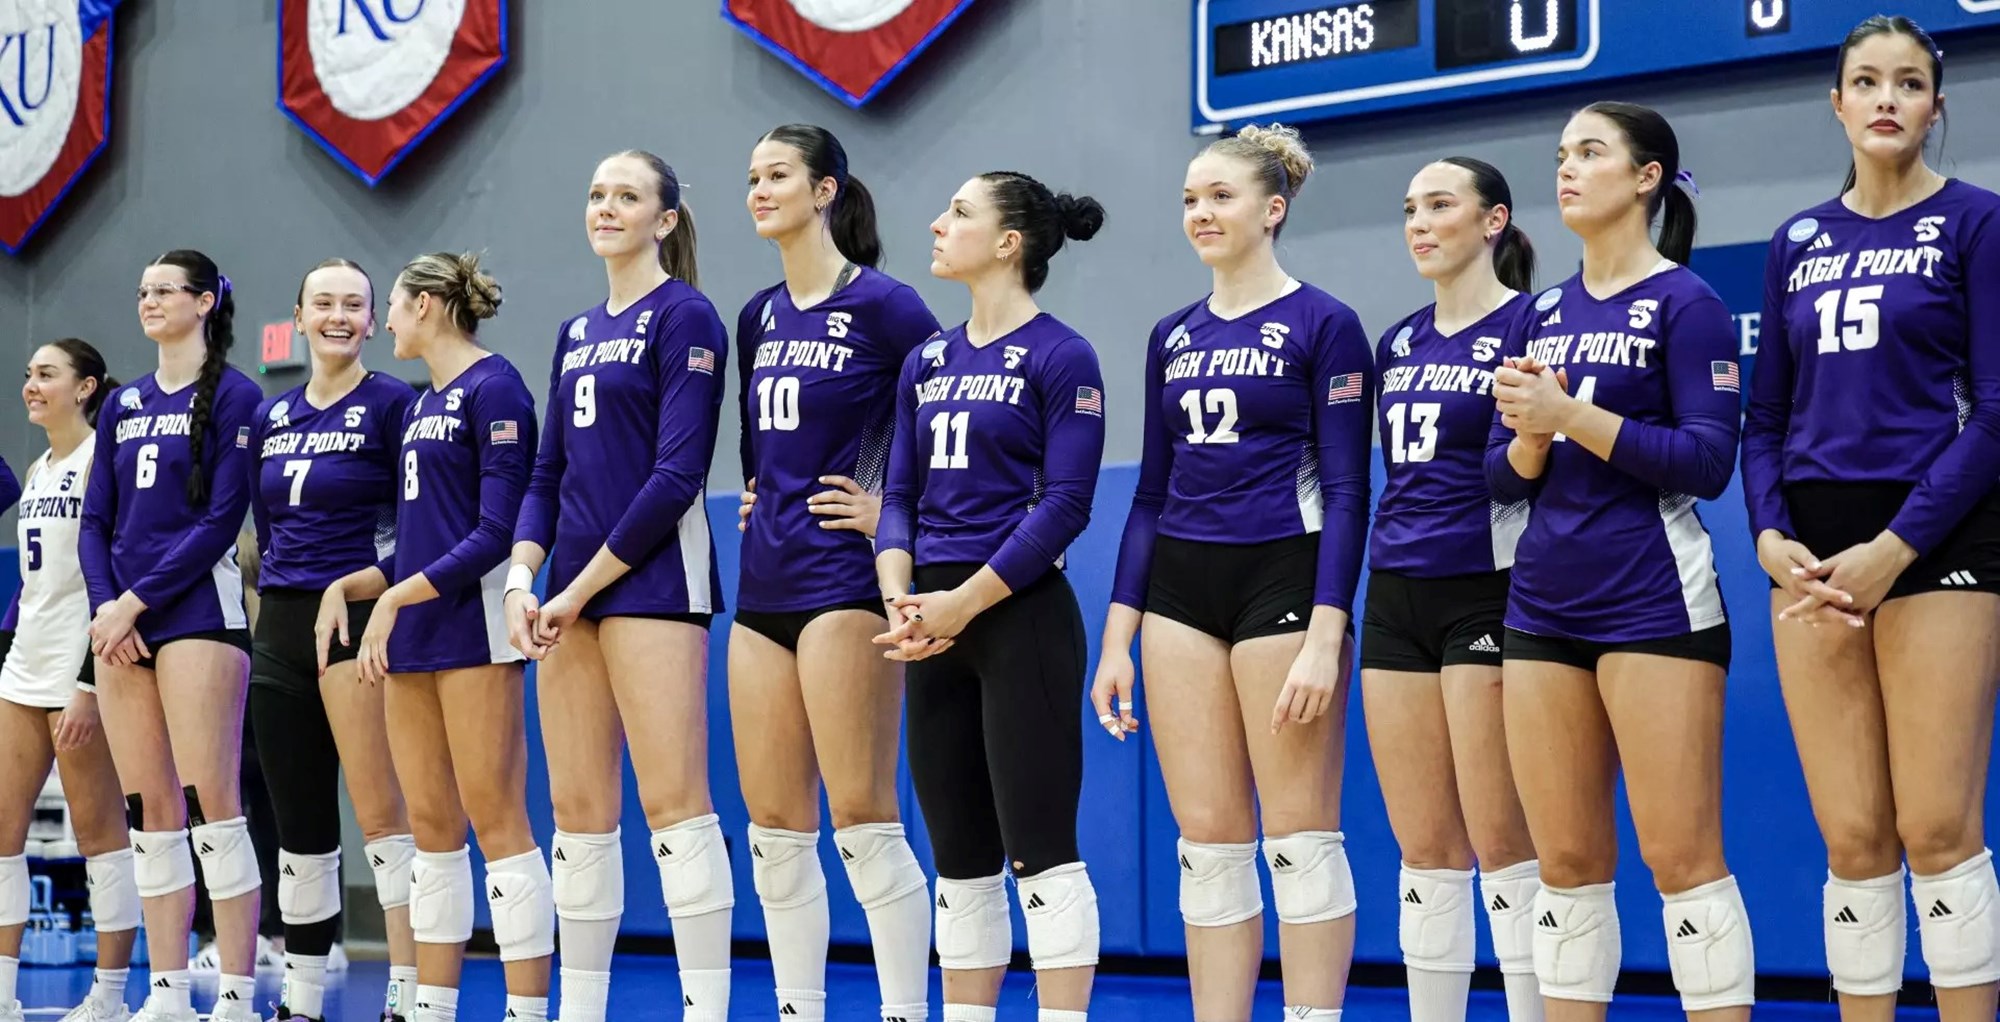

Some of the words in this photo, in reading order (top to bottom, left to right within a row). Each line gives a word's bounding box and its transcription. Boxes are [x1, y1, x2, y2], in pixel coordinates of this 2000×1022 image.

[1251, 4, 1374, 67] KANSAS
[1787, 253, 1850, 292] HIGH
[1851, 245, 1944, 278] POINT
[1814, 284, 1884, 355] 15
[590, 338, 646, 364] POINT
[781, 340, 854, 372] POINT
[1206, 348, 1290, 377] POINT
[1572, 332, 1656, 368] POINT
[573, 374, 596, 428] 9
[953, 375, 1025, 405] POINT
[1414, 364, 1495, 395] POINT
[151, 413, 192, 437] POIN
[757, 376, 800, 431] 10
[1179, 388, 1239, 444] 12
[301, 433, 365, 455] POINT
[930, 412, 970, 469] 11
[1386, 403, 1441, 463] 13
[136, 443, 159, 489] 6
[283, 460, 312, 506] 7
[404, 450, 419, 501] 8
[33, 496, 81, 519] POINT
[27, 528, 42, 571] 5
[1469, 644, 1500, 652] adidas
